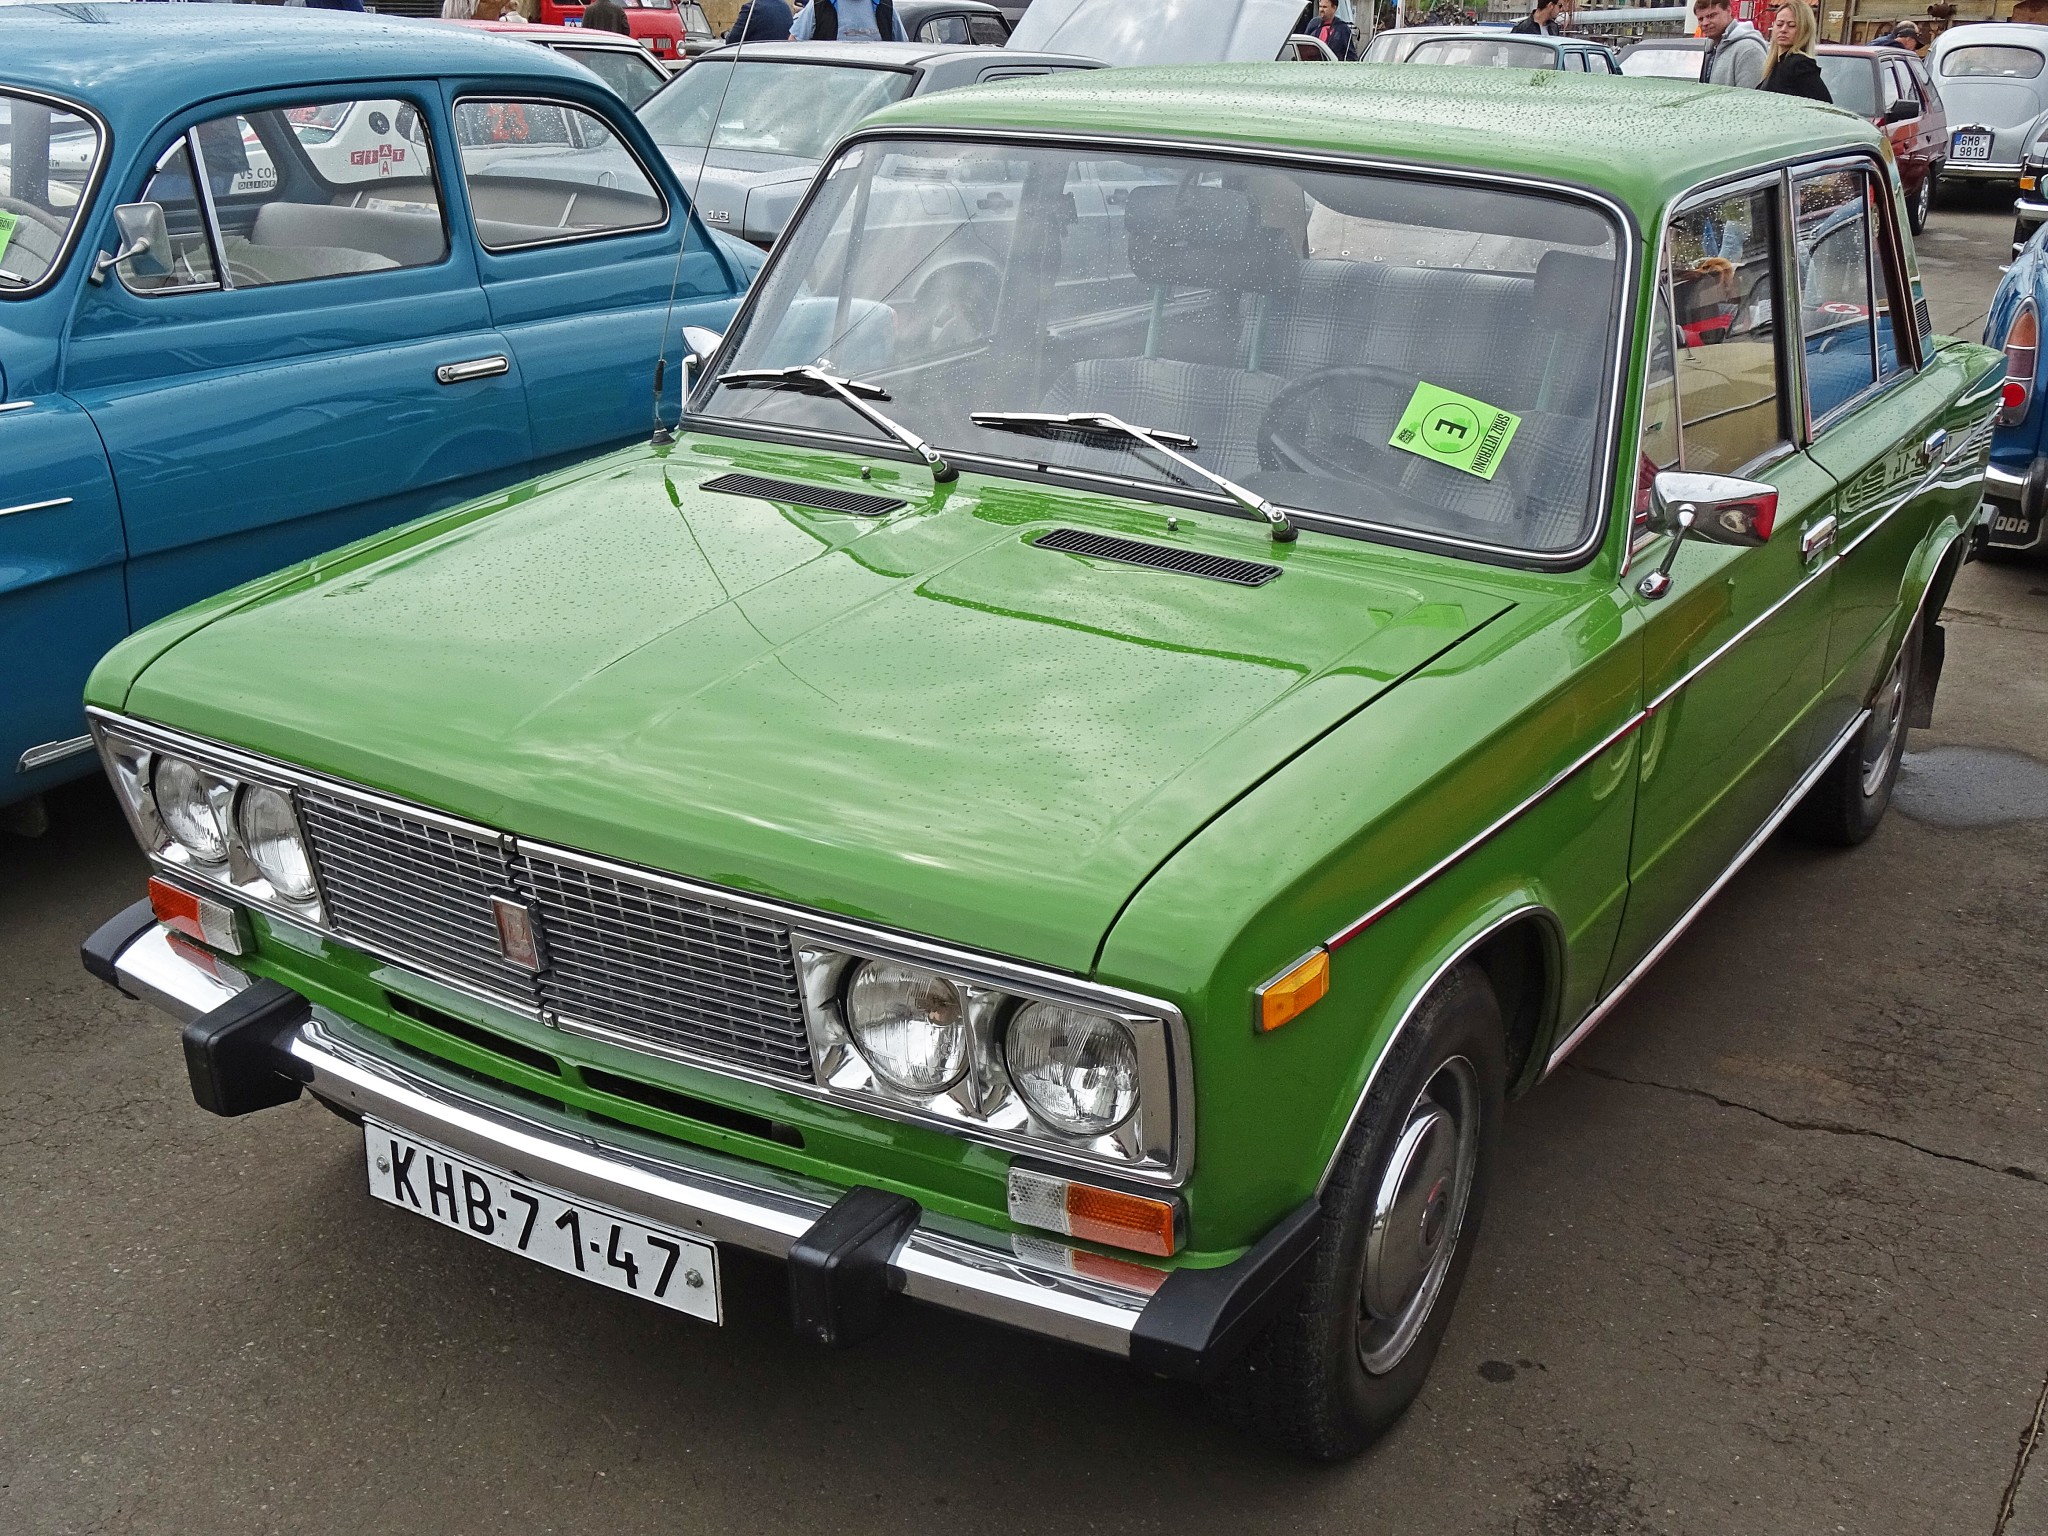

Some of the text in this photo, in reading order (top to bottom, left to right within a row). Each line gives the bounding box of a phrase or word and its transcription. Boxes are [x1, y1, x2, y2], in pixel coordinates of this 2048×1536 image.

[351, 144, 406, 165] FIAT
[1959, 147, 1985, 157] 9818
[708, 210, 729, 220] 1.8
[1434, 418, 1468, 440] E
[1490, 413, 1511, 436] SRAZ
